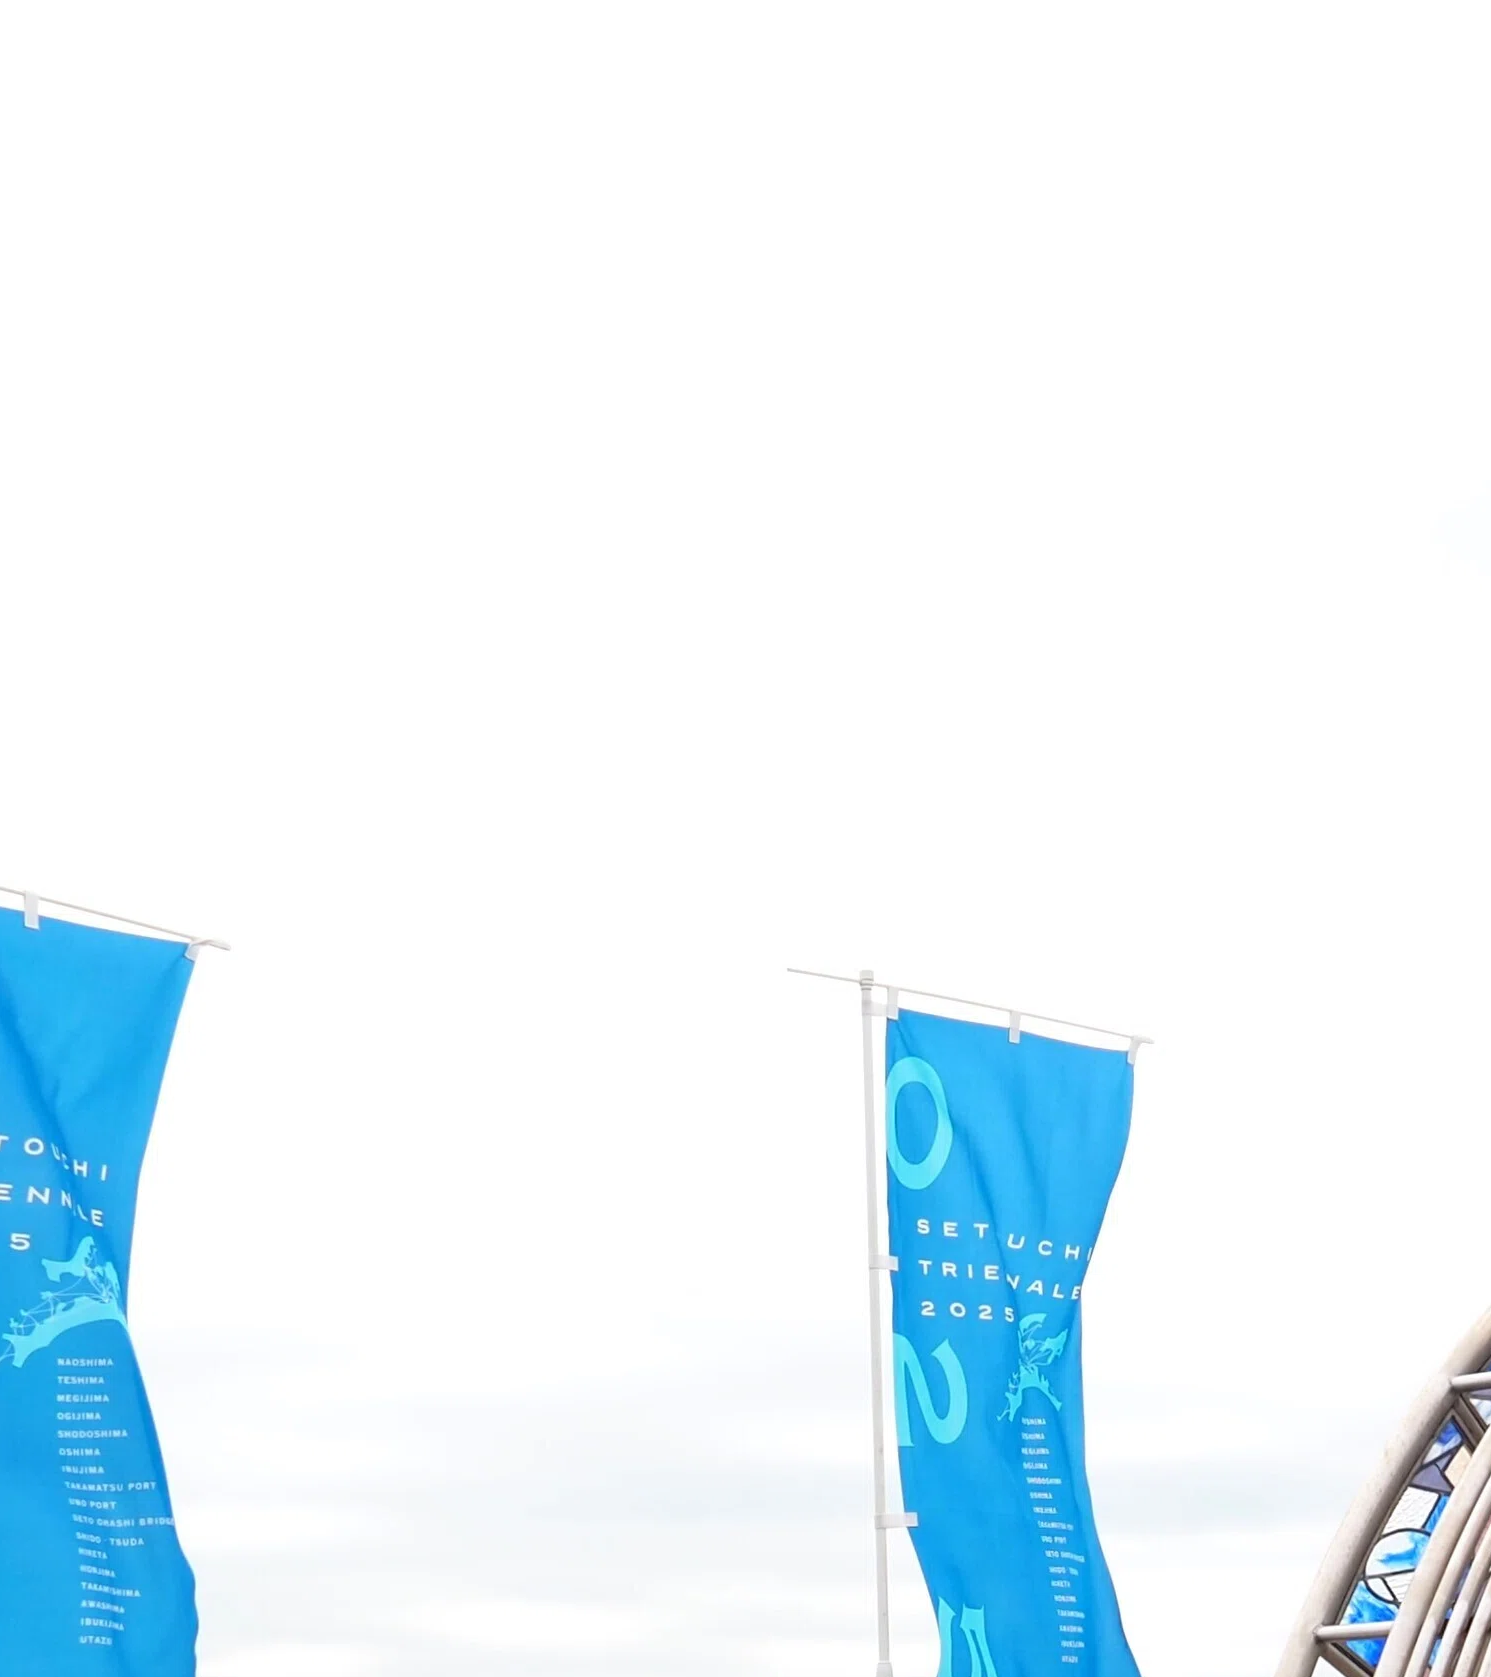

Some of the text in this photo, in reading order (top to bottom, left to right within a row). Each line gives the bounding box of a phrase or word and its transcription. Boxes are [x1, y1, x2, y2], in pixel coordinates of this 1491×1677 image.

[916, 1219, 1093, 1262] SETUCHI
[921, 1301, 1014, 1323] 2025
[57, 1376, 105, 1385] TESHIMA
